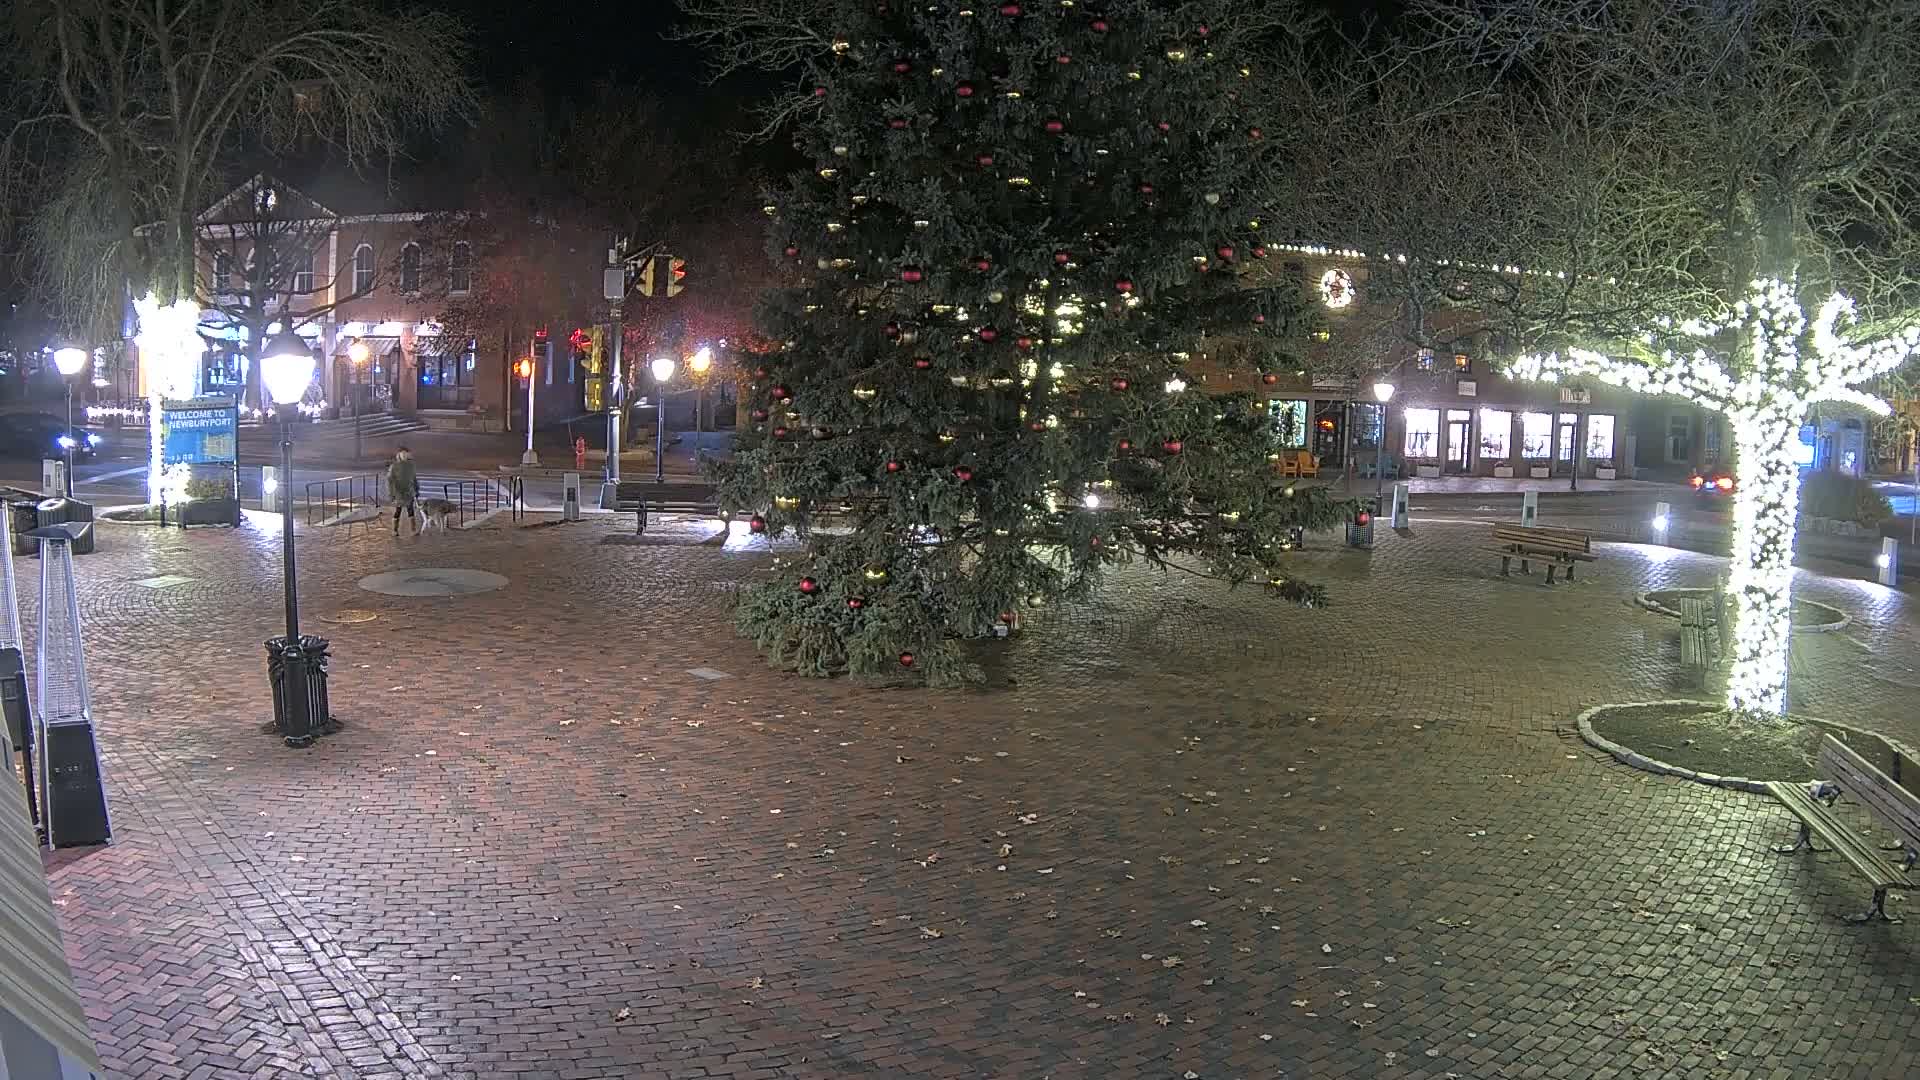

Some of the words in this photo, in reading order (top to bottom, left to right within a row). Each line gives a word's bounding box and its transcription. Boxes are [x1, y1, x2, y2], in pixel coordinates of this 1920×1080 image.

[169, 410, 212, 420] WELCOME
[214, 409, 226, 418] TO
[169, 418, 232, 429] NEWBURYPORT
